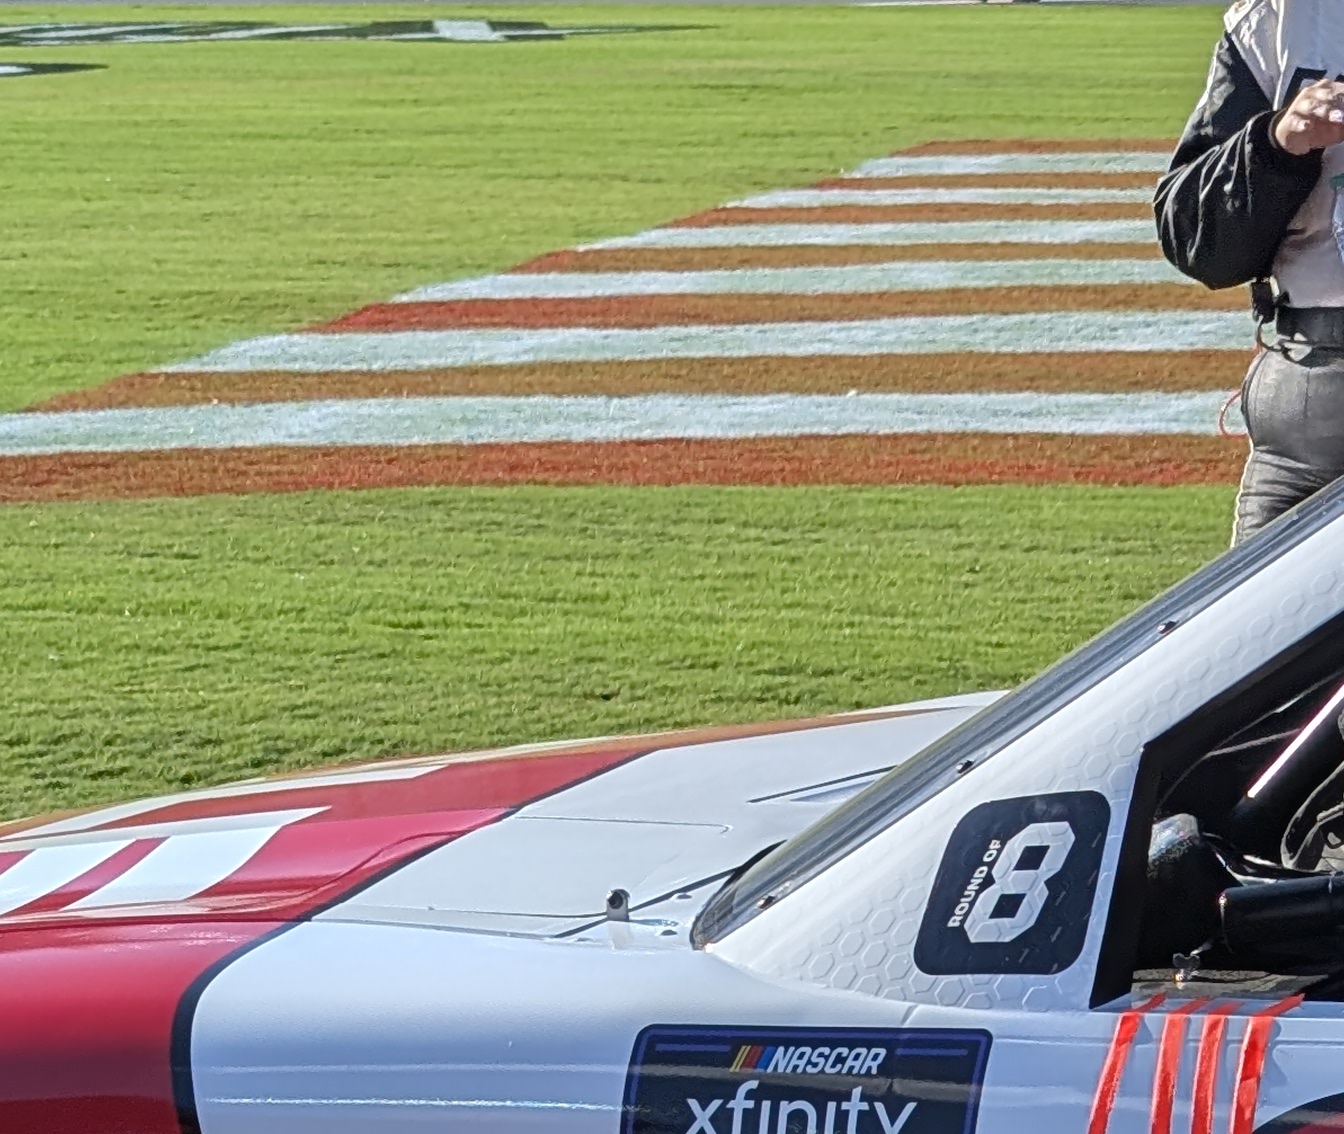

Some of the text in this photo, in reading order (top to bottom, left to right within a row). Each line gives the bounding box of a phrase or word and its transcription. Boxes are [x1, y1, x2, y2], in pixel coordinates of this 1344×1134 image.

[947, 839, 1001, 928] ROUND OF
[963, 821, 1076, 943] 8
[766, 1046, 887, 1076] NASCAR
